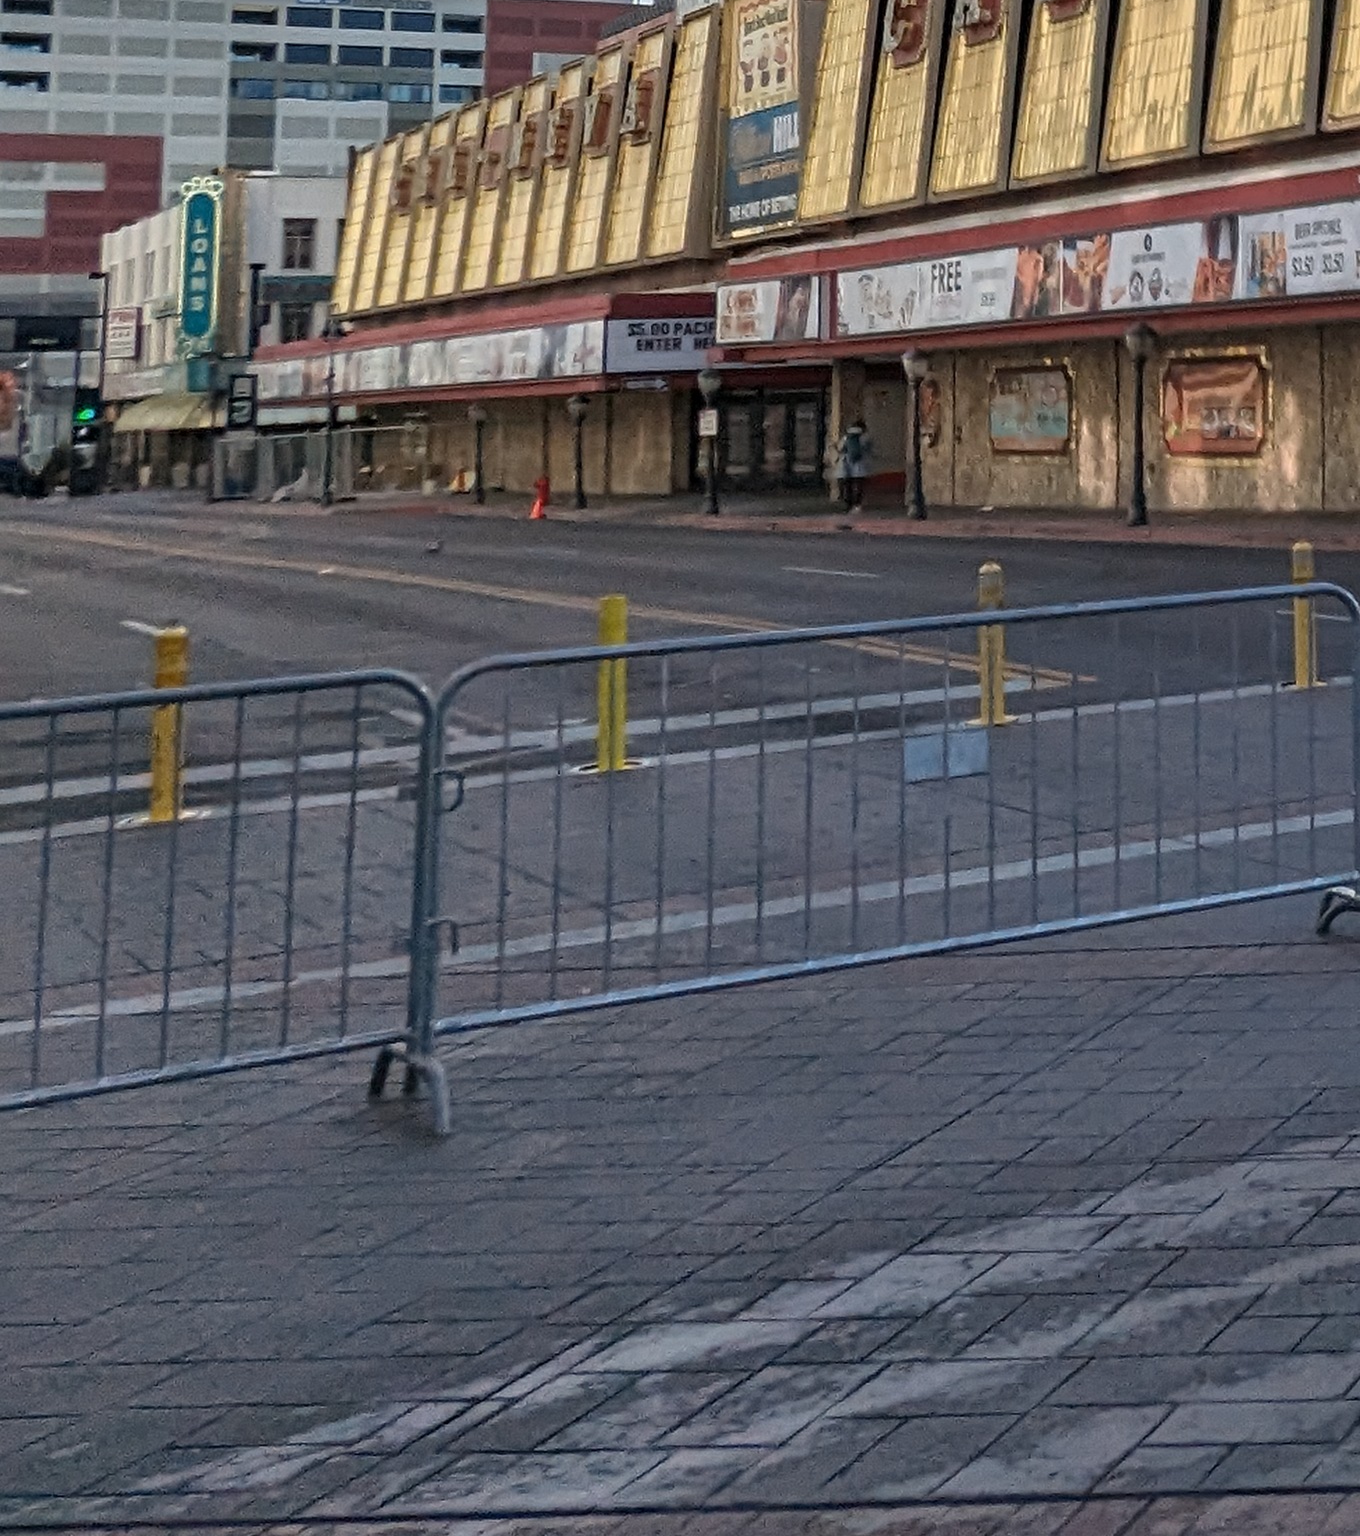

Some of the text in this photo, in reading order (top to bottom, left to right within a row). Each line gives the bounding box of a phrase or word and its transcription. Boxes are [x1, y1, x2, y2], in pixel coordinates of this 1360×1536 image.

[189, 217, 210, 312] LOANS
[931, 260, 962, 294] FREE
[636, 337, 682, 352] ENTER
